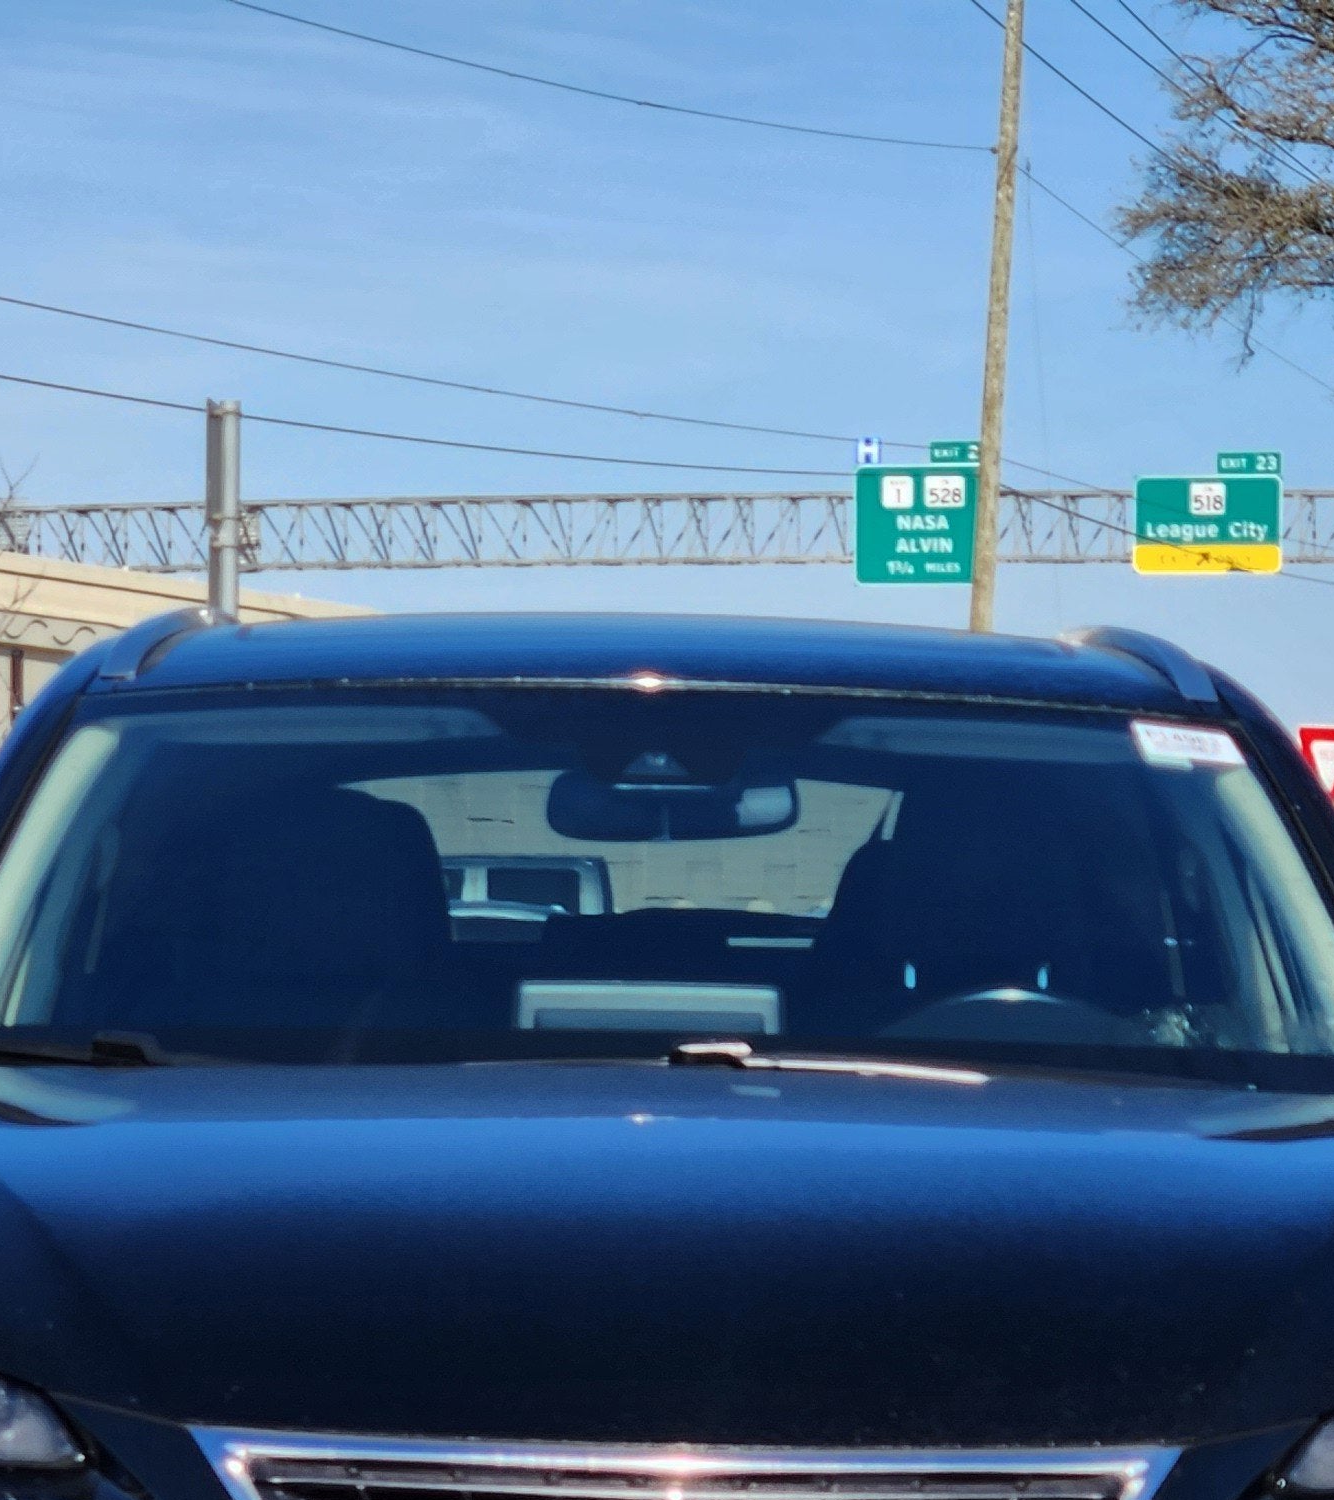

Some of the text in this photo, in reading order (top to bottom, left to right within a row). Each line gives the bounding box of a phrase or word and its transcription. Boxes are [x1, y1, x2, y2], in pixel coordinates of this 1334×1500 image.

[934, 447, 959, 458] EXIT
[1221, 455, 1278, 471] EXIT 23
[929, 487, 962, 504] 528
[1193, 494, 1224, 511] 518
[896, 514, 950, 531] NASA
[1145, 520, 1269, 542] League City
[895, 536, 953, 554] ALVIN
